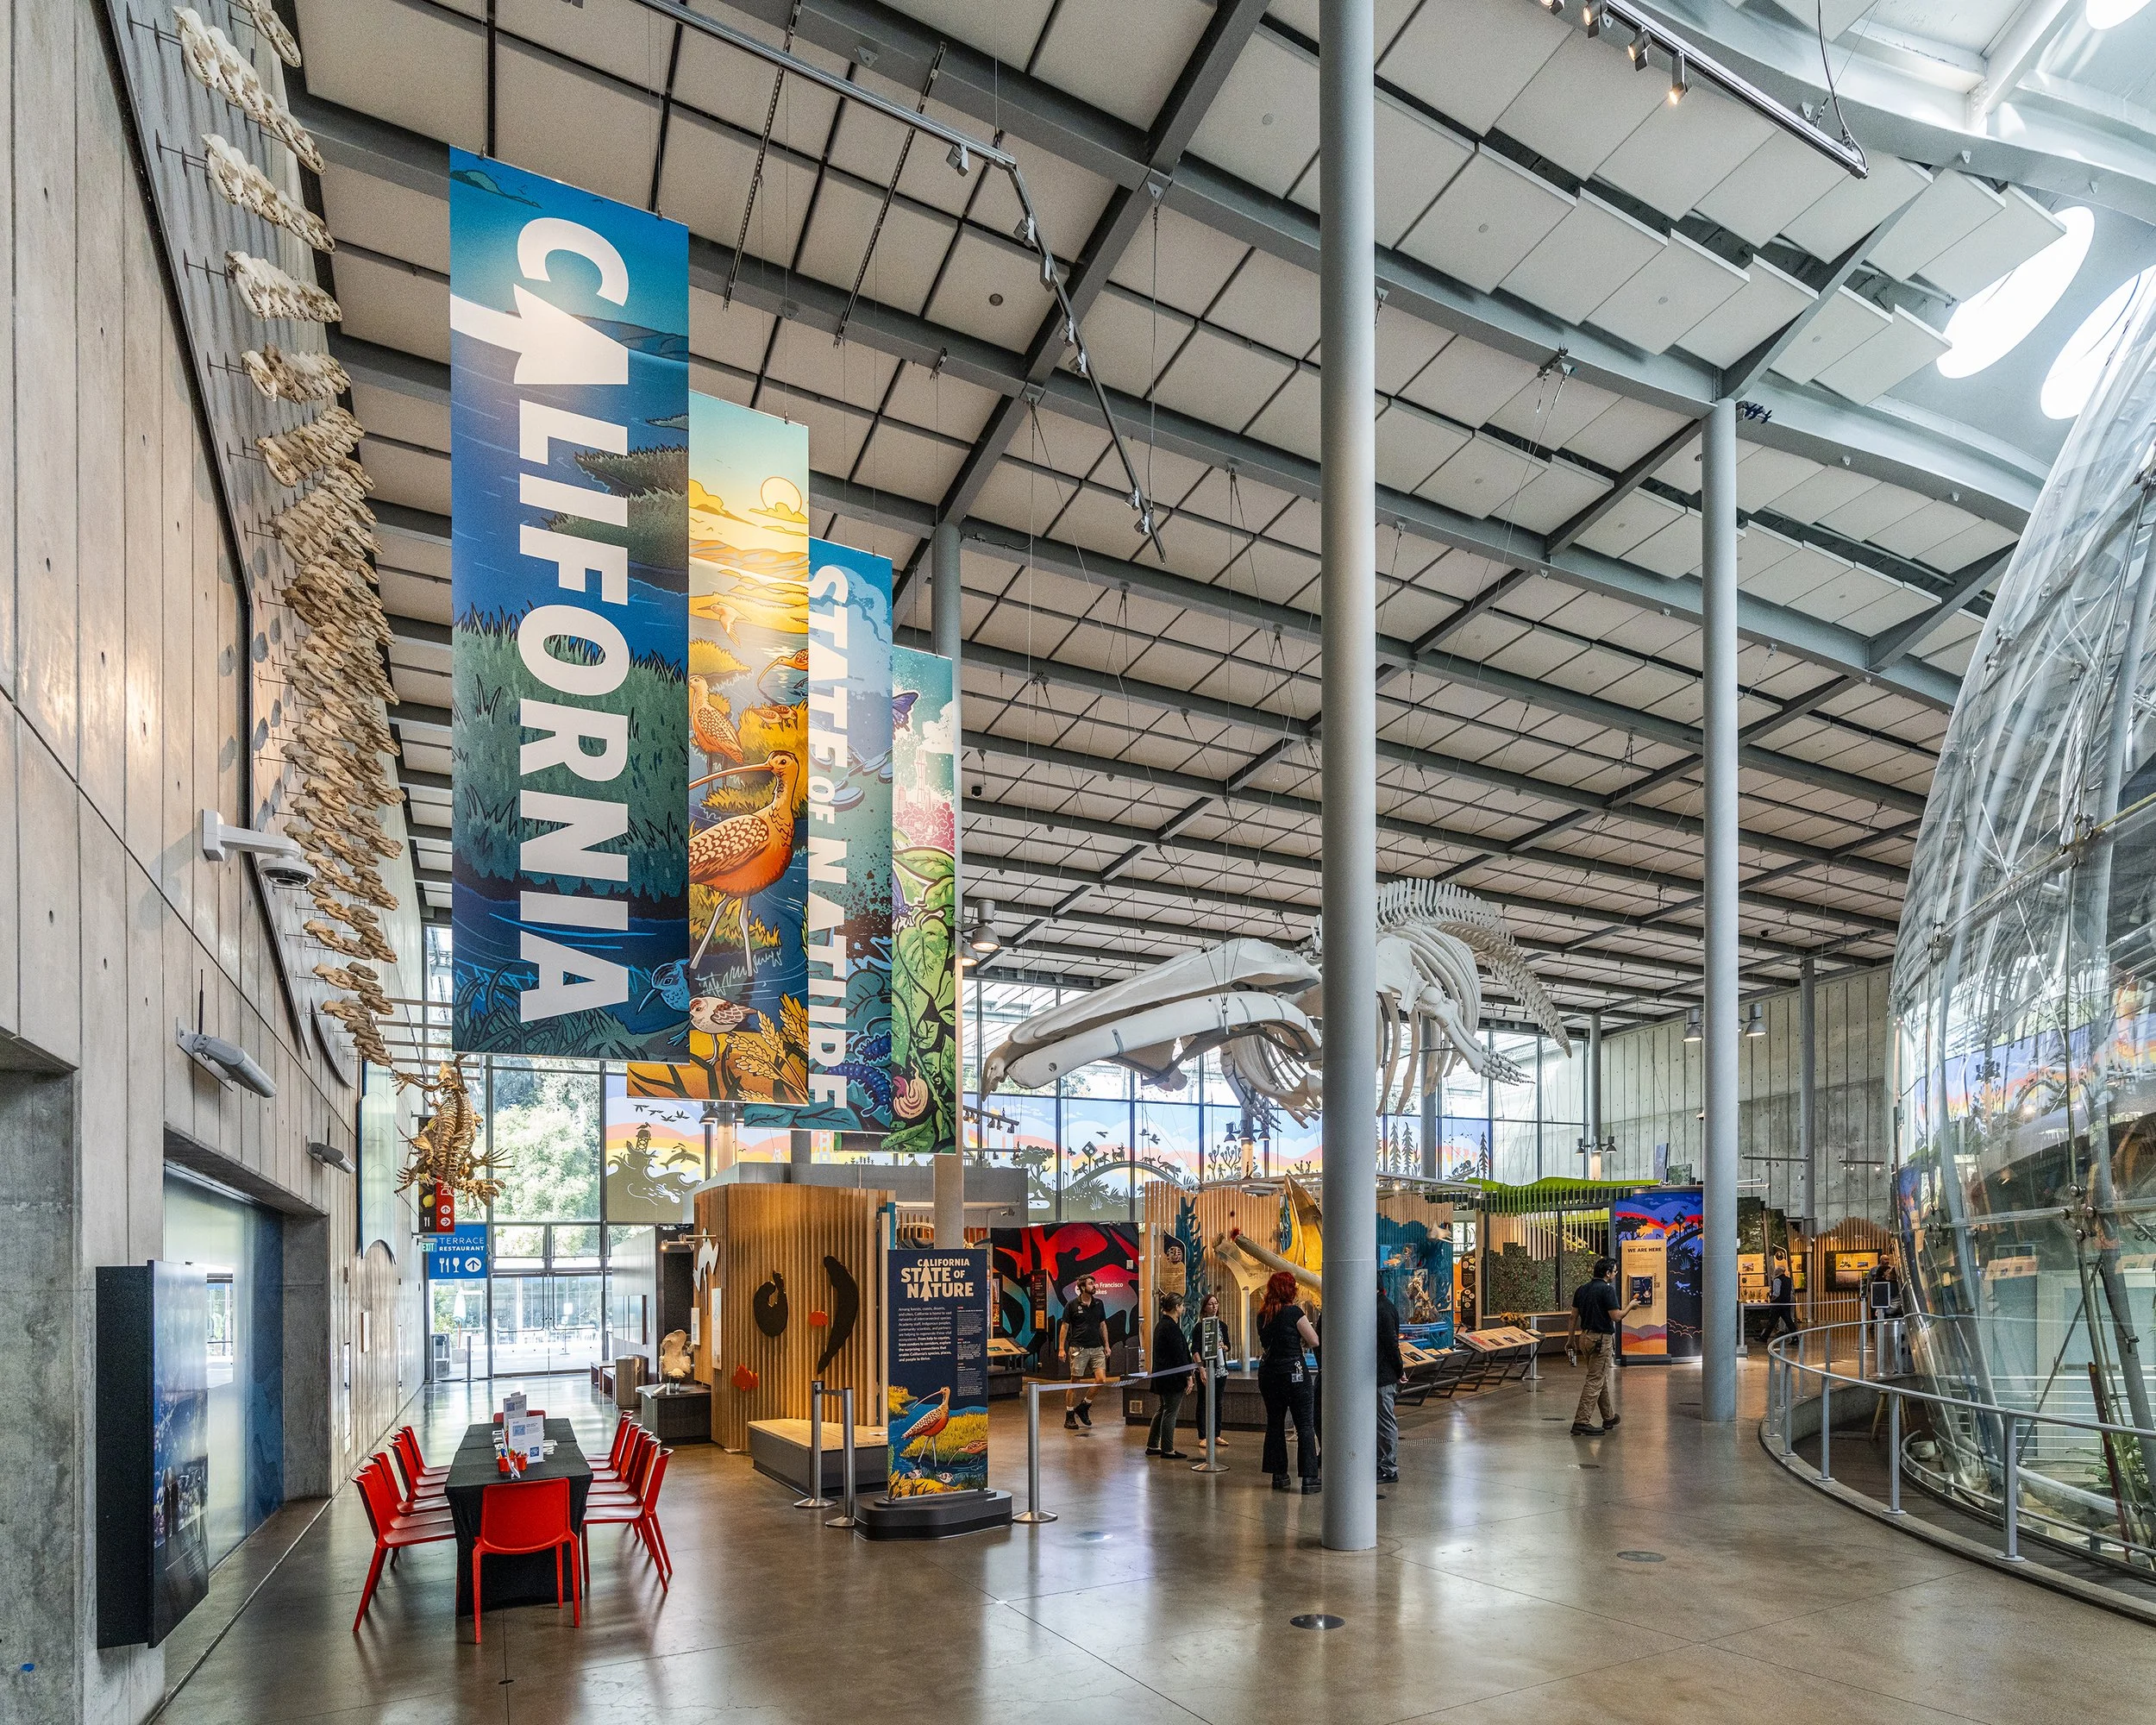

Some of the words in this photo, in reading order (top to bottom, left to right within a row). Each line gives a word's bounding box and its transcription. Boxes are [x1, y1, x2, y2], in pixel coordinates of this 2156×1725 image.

[451, 217, 629, 1023] CALIFORNIA
[809, 565, 849, 768] STATE
[809, 776, 836, 825] OF
[422, 1243, 435, 1251] EXIT
[900, 1267, 951, 1283] STATE
[953, 1270, 966, 1278] OF
[906, 1283, 975, 1301] NATURE
